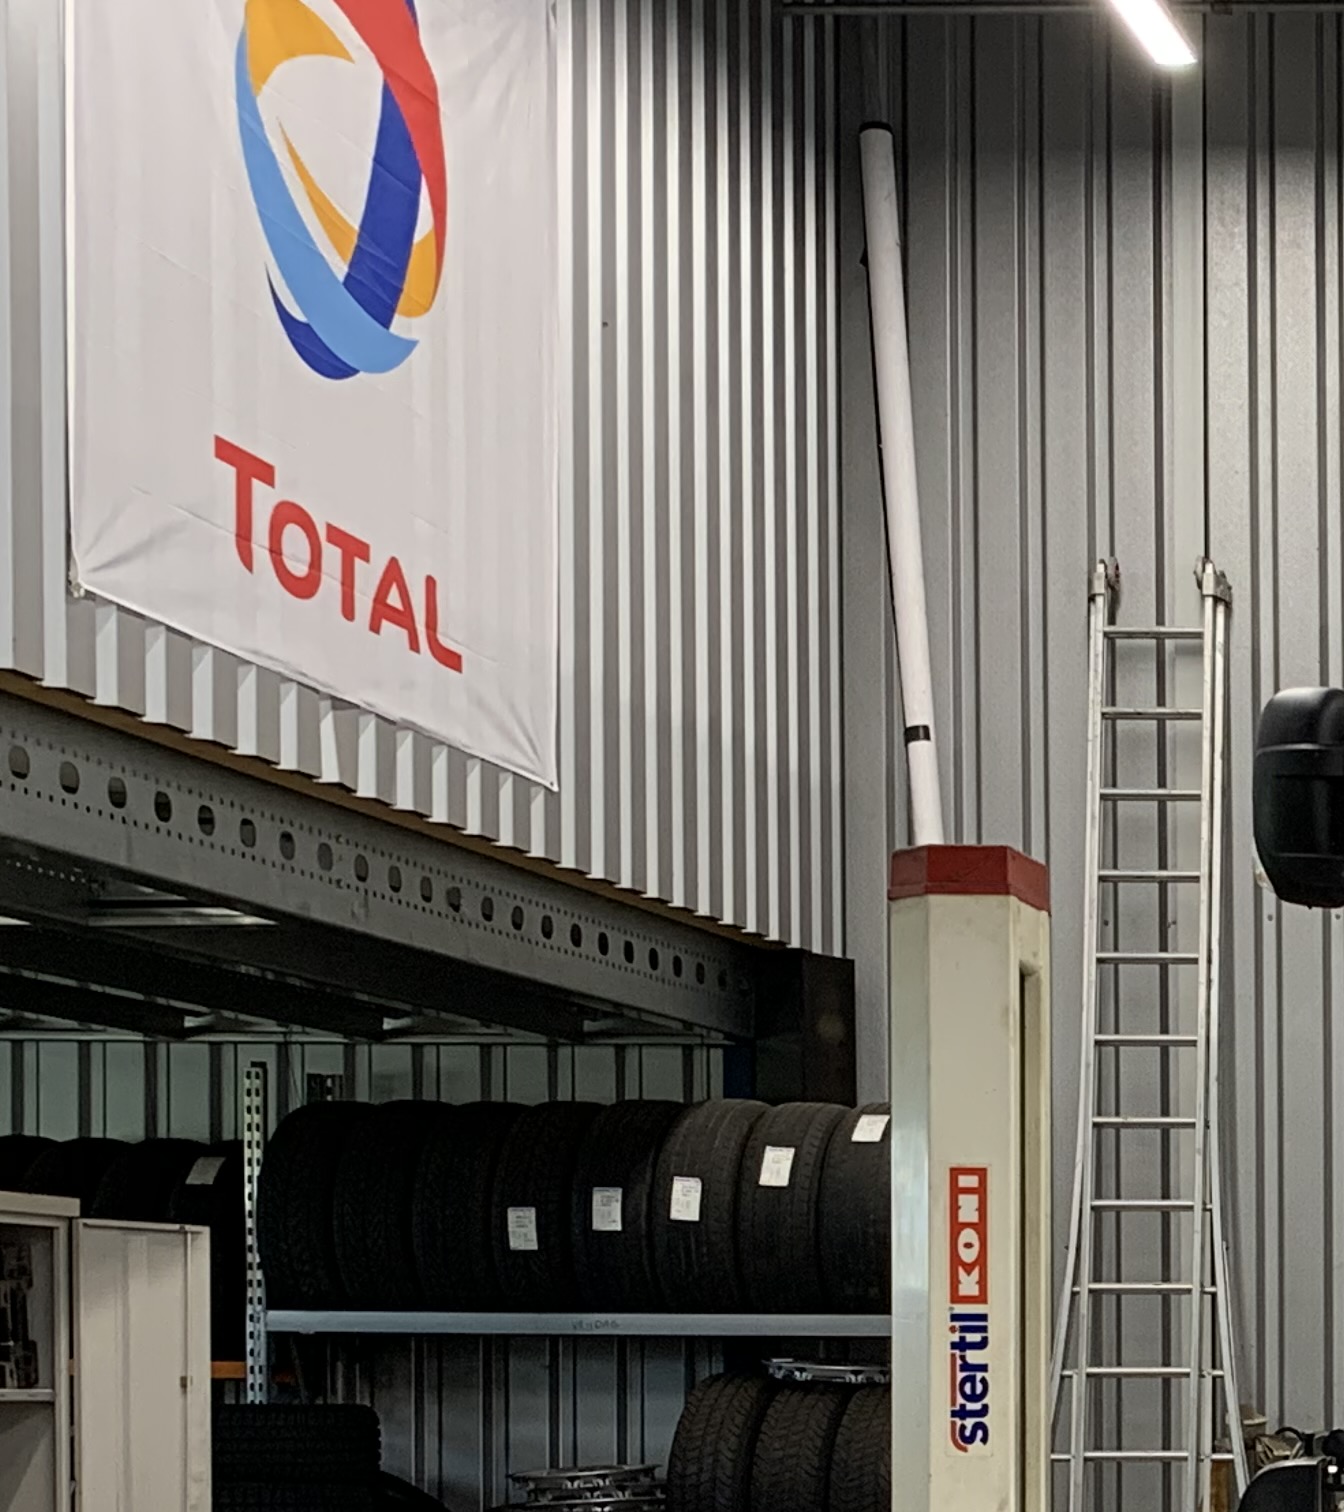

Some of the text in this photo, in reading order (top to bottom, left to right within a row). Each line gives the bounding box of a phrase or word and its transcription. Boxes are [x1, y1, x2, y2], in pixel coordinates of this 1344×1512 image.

[213, 433, 463, 675] TOTAL
[949, 1172, 989, 1449] stertil KONI
